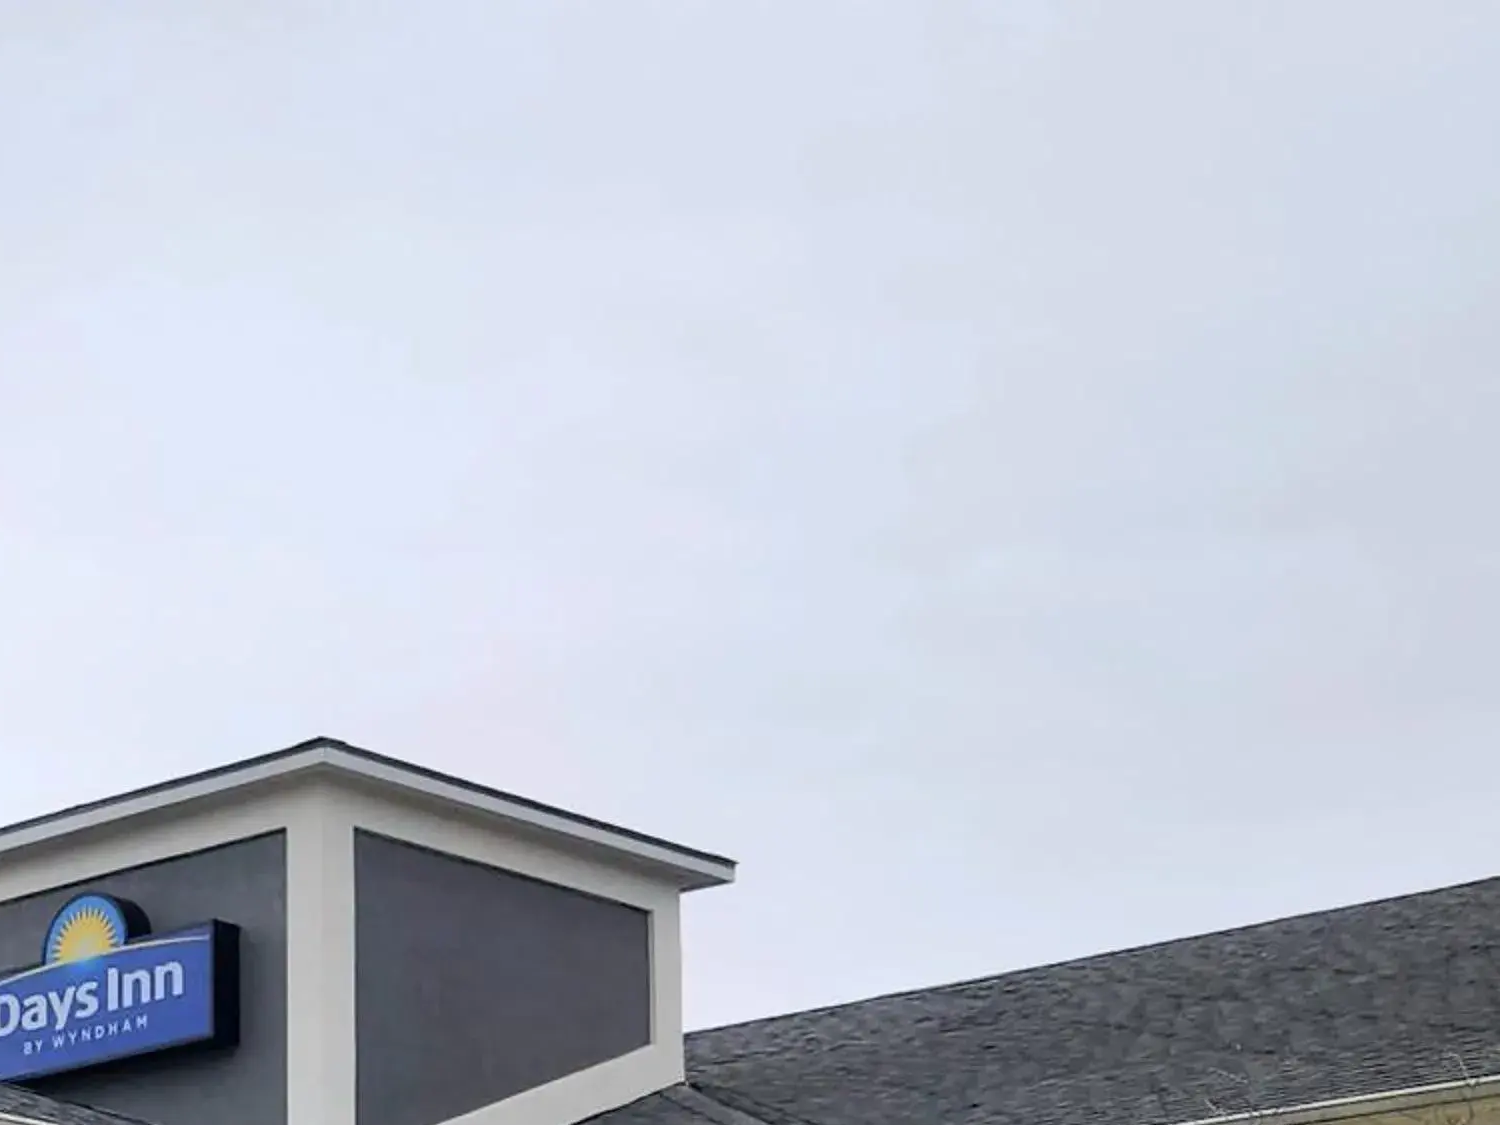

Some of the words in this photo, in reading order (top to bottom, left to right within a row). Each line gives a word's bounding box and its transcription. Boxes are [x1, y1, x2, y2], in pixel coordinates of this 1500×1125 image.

[107, 960, 184, 1012] Inn
[22, 1039, 44, 1056] BY
[51, 1014, 149, 1049] WYNDHAM
